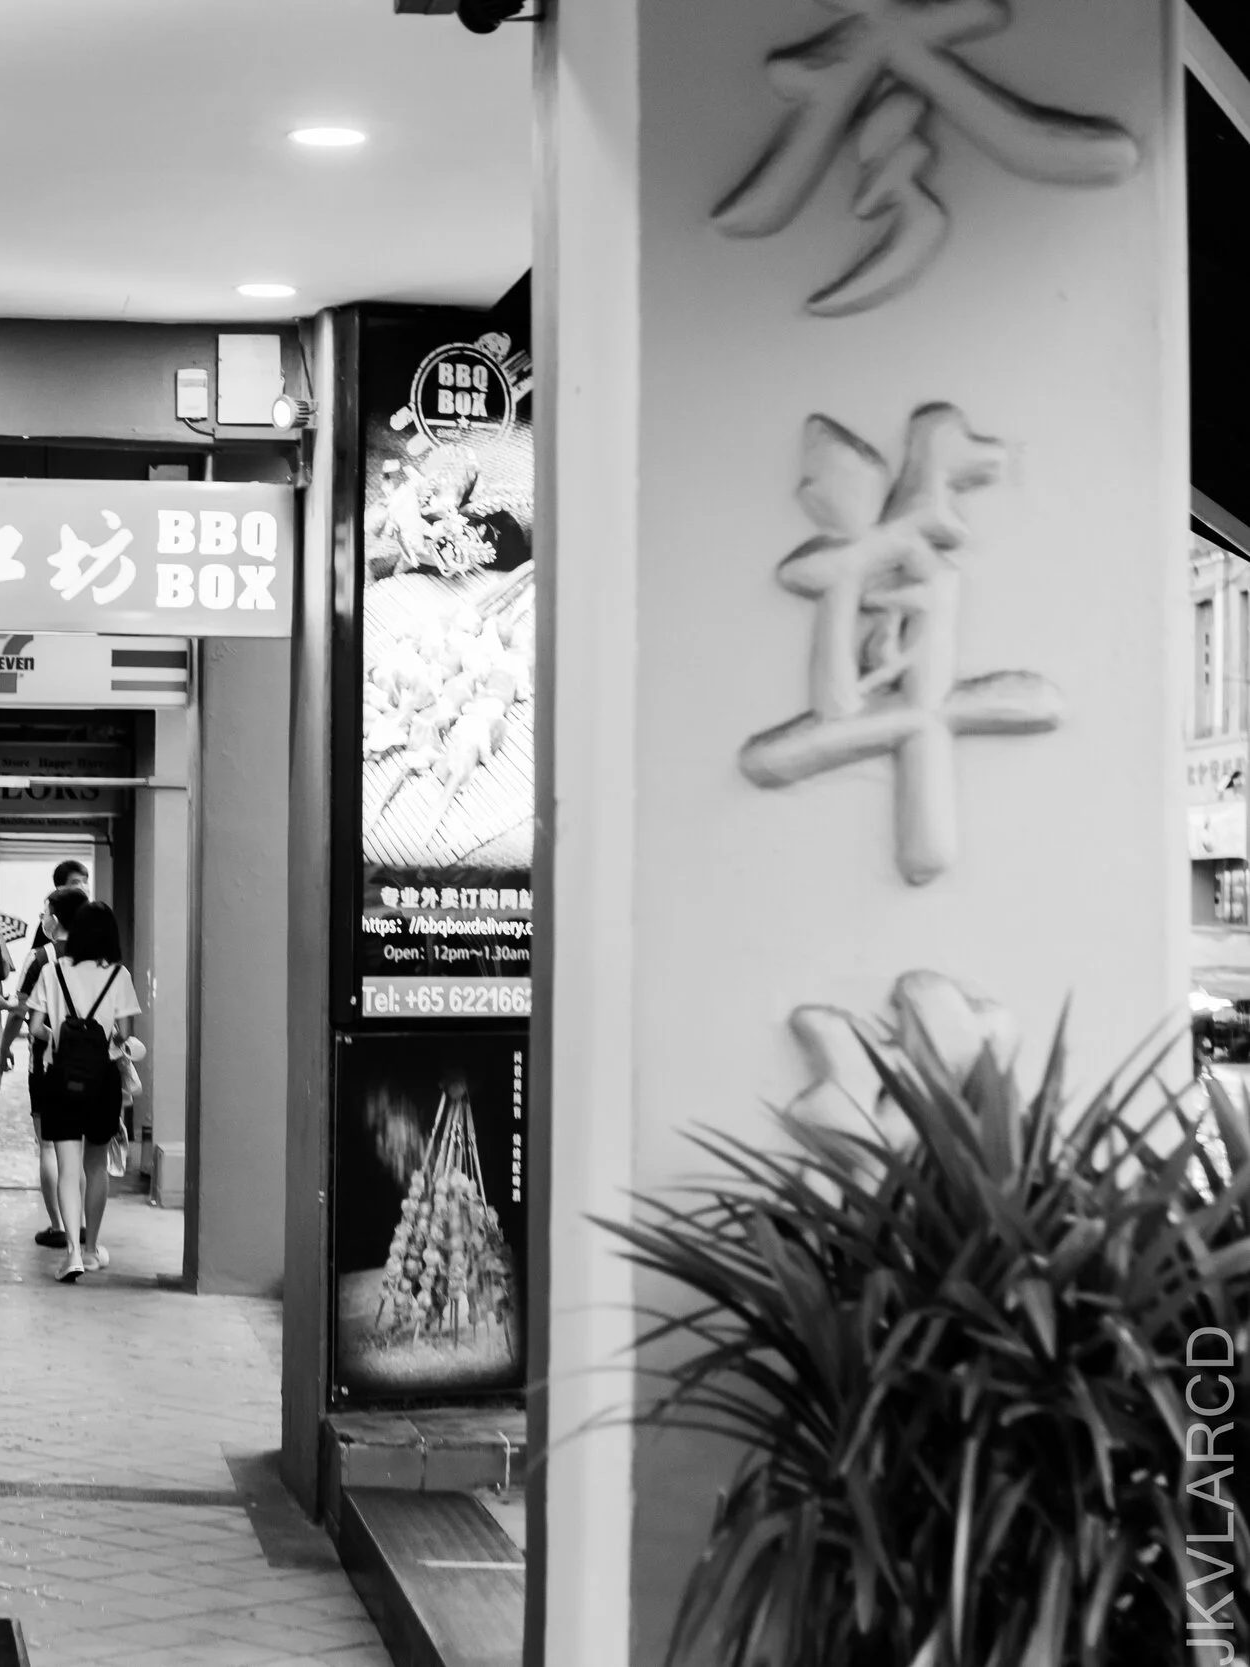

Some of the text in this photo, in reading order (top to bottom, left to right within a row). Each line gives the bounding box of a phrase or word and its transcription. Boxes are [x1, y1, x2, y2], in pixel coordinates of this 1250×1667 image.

[438, 362, 489, 392] BBQ
[437, 388, 488, 417] BOX
[156, 509, 278, 561] BBQ
[155, 563, 277, 610] BOX
[362, 915, 402, 937] https:
[383, 944, 425, 963] Open:
[362, 984, 400, 1013] Tel:
[405, 985, 445, 1013] +65
